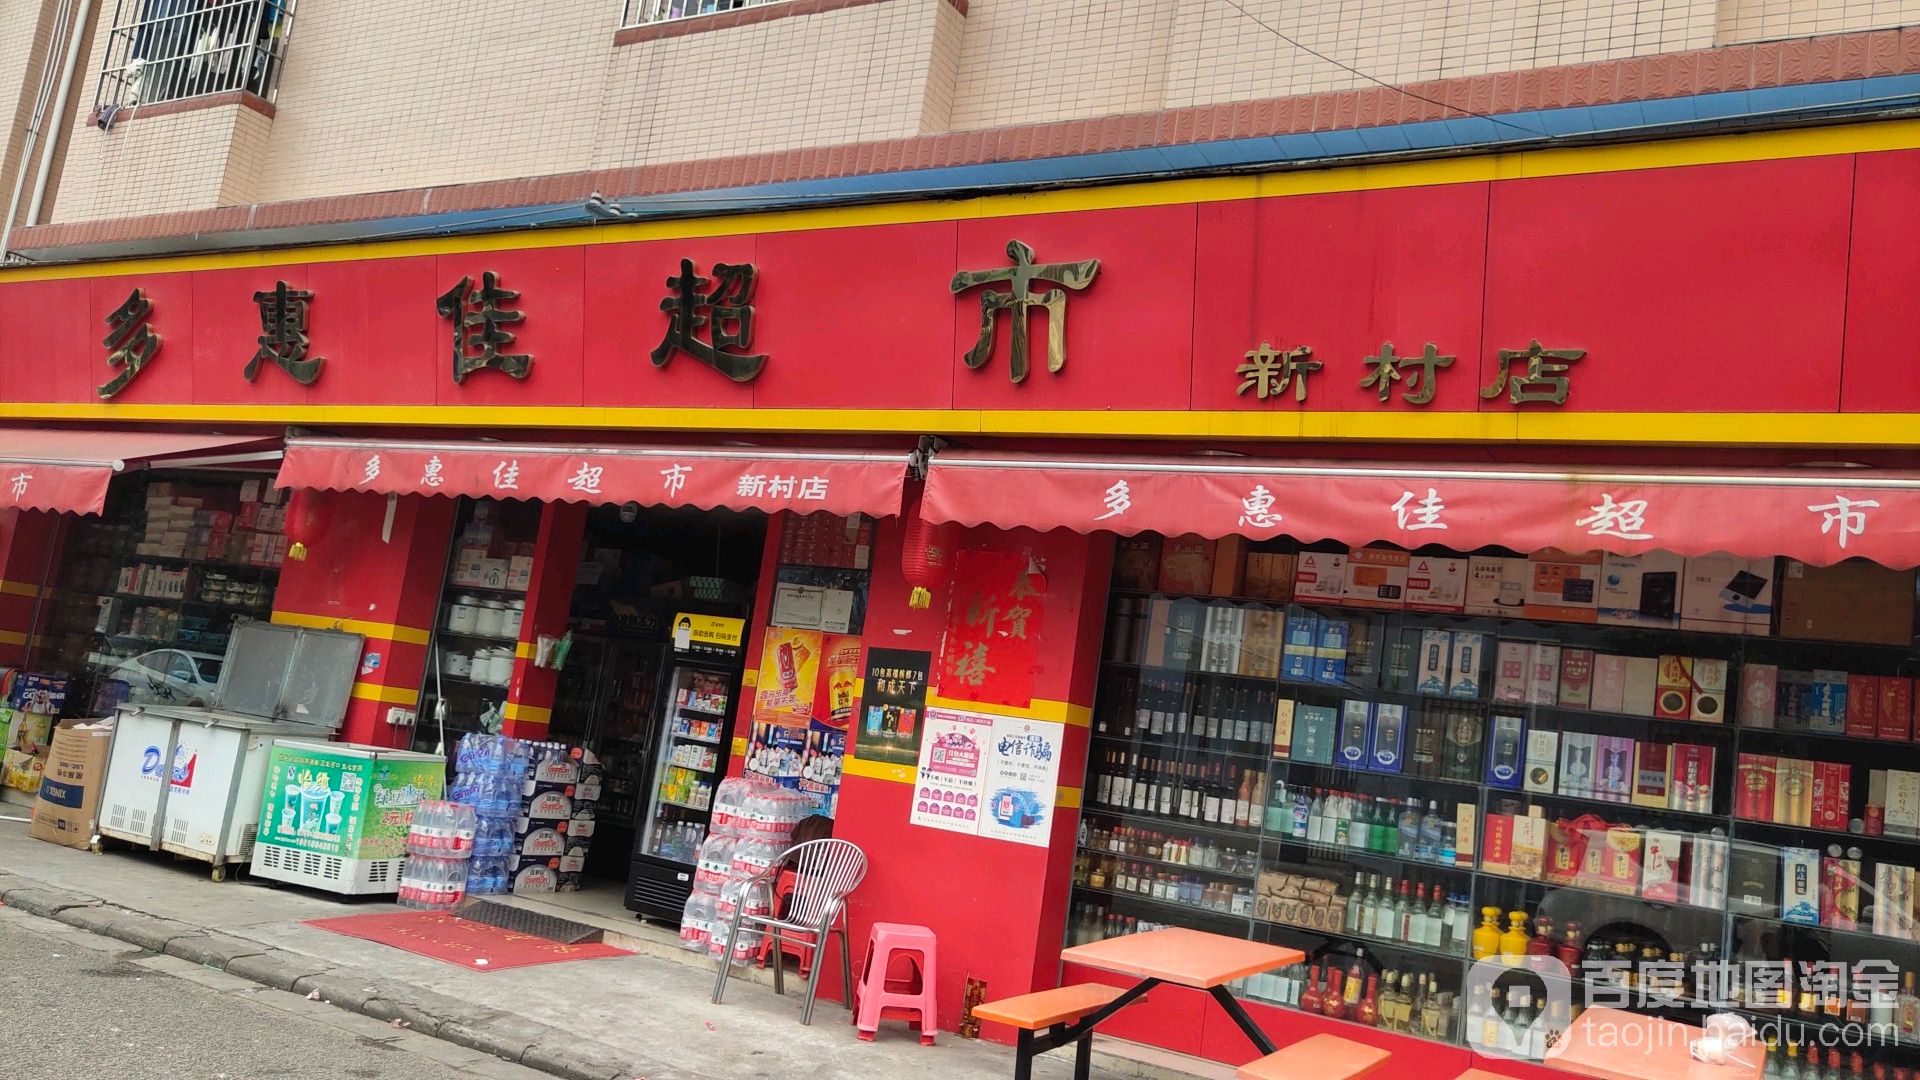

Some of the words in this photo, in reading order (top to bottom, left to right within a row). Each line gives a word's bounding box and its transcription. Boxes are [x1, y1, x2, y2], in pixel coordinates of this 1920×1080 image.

[97, 238, 1101, 401] 多惠佳超市
[1235, 339, 1589, 406] 新村店
[10, 471, 34, 502] 市
[362, 453, 694, 499] 多惠佳超市
[736, 472, 830, 501] 新村店
[1092, 478, 1880, 549] 多惠佳超市
[876, 678, 917, 695] 和成天下
[997, 736, 1053, 762] 电信诈骗
